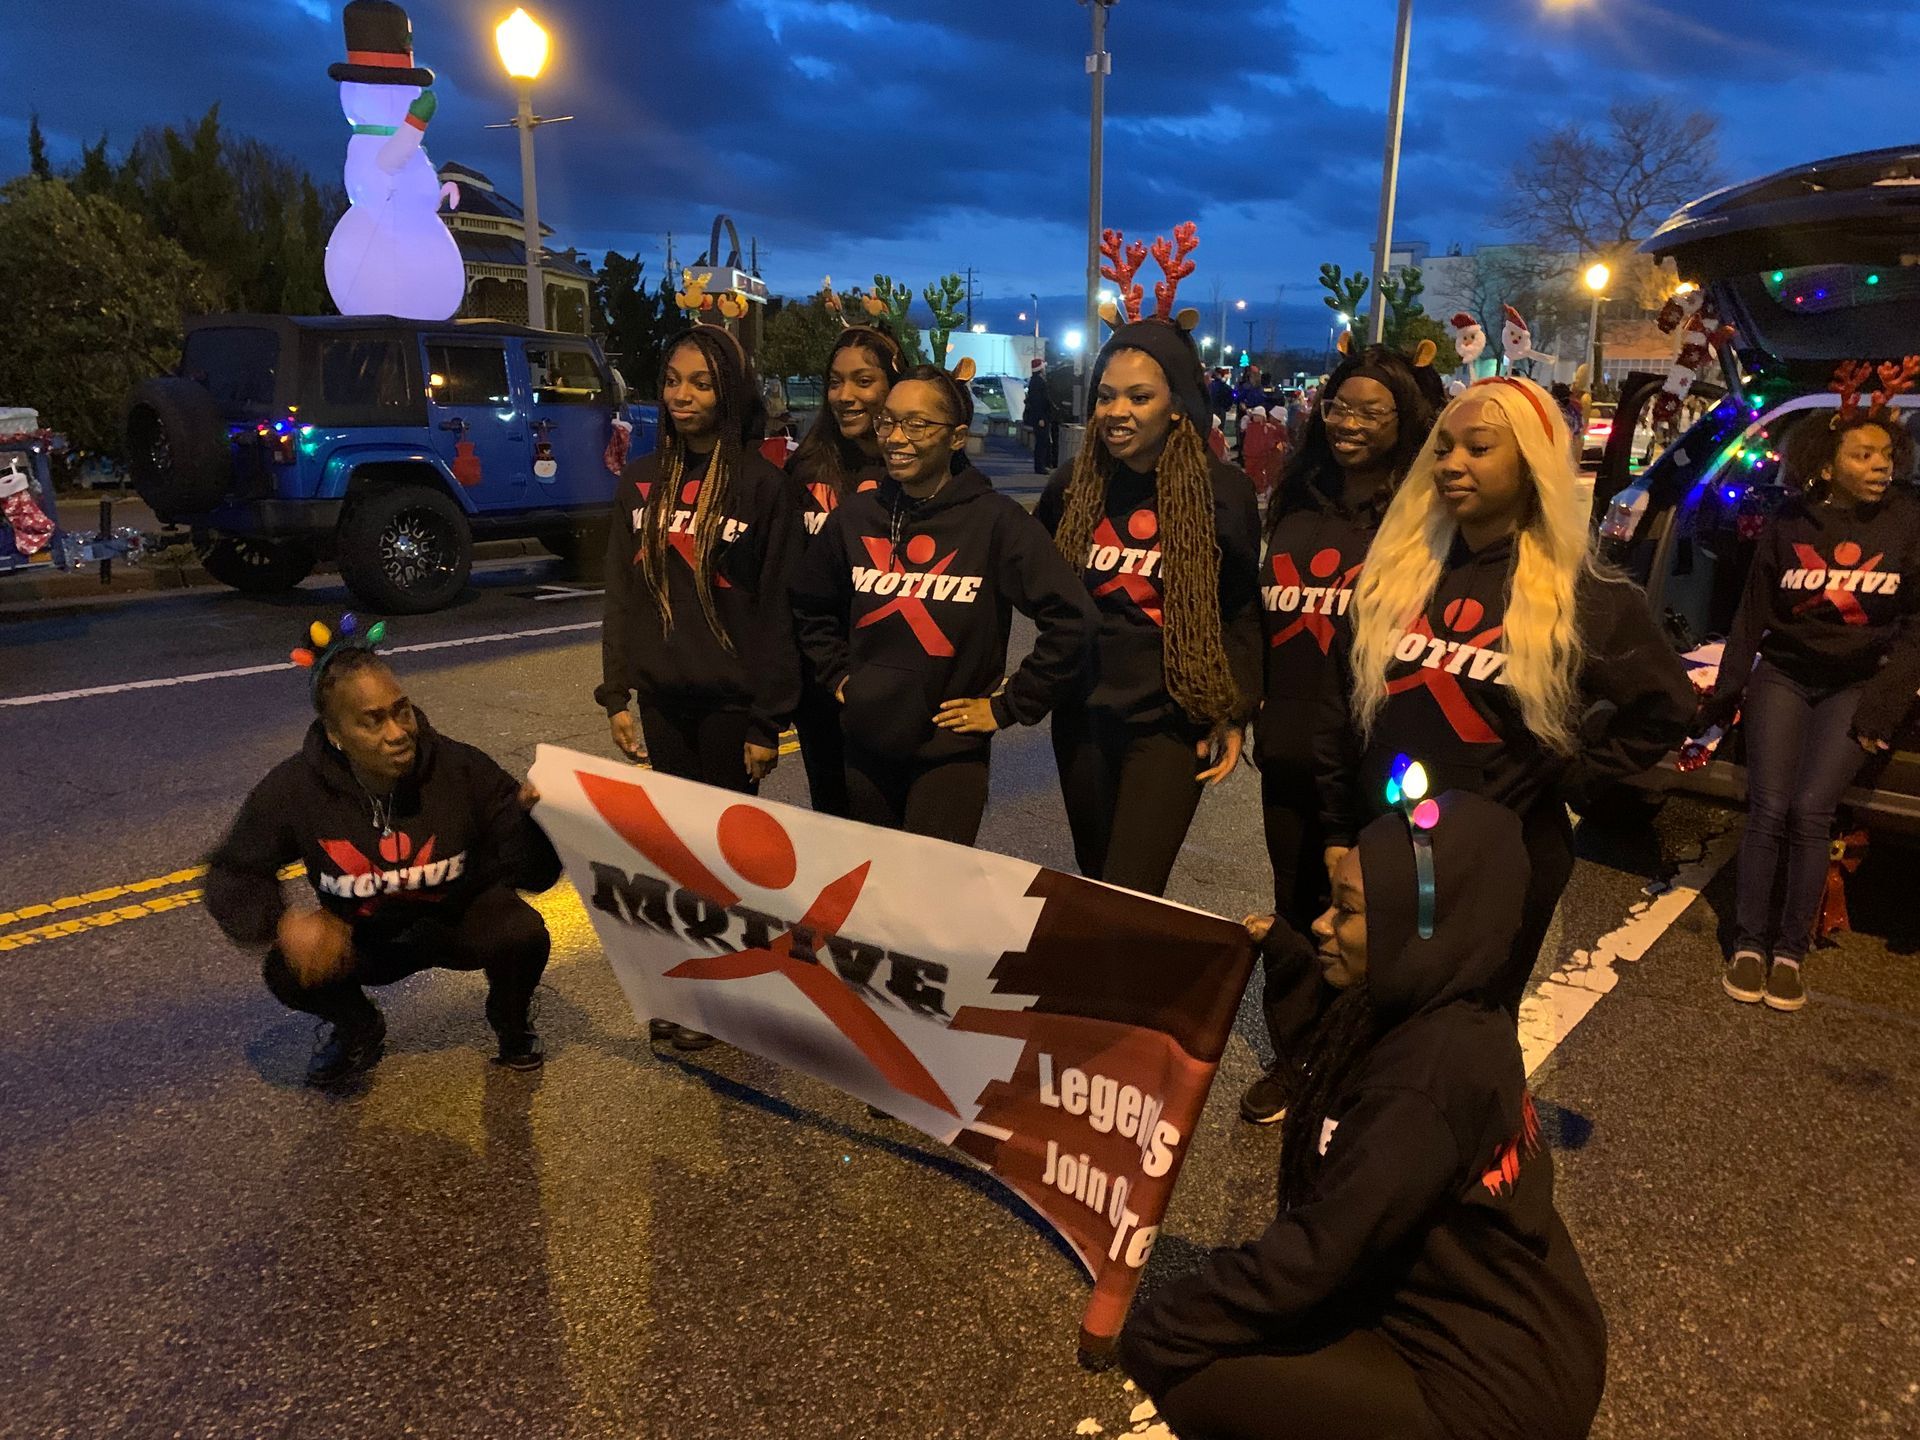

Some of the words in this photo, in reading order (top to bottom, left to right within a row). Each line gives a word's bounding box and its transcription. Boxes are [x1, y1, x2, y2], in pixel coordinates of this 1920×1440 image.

[632, 507, 749, 543] MTIE
[852, 566, 983, 603] MOTIVE
[1086, 543, 1163, 578] OTI
[1780, 568, 1900, 595] MOTIVE
[1388, 628, 1511, 686] OTIV
[319, 851, 466, 899] MOTIVE
[590, 861, 950, 1012] MOTIVE
[1038, 1053, 1180, 1178] Legens
[1042, 1140, 1108, 1214] Join
